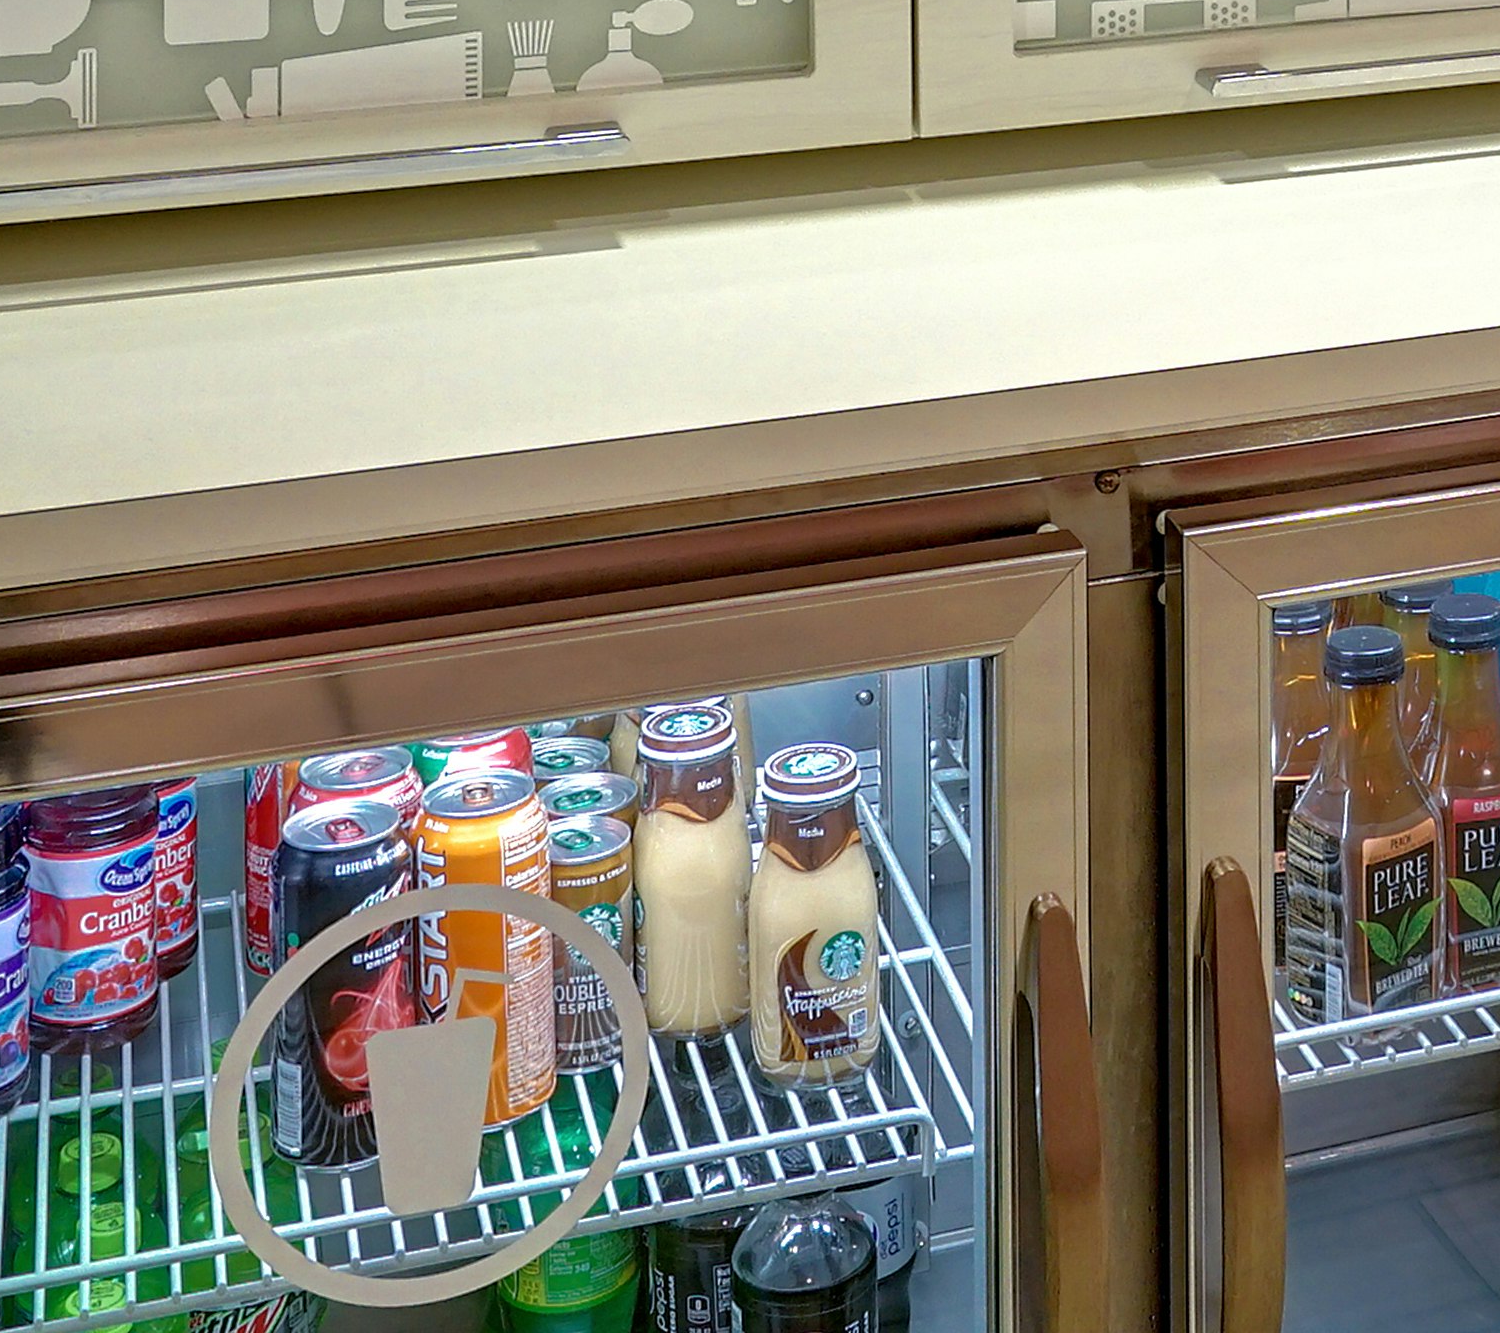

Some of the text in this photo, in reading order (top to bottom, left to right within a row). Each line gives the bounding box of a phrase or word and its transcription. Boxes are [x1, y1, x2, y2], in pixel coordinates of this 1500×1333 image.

[103, 869, 134, 887] Ocean
[1373, 852, 1429, 893] PURE
[352, 934, 407, 966] ENERGY
[1375, 962, 1429, 995] BREWED TEA
[784, 983, 868, 1021] frappuccino
[886, 1197, 901, 1255] pepsi
